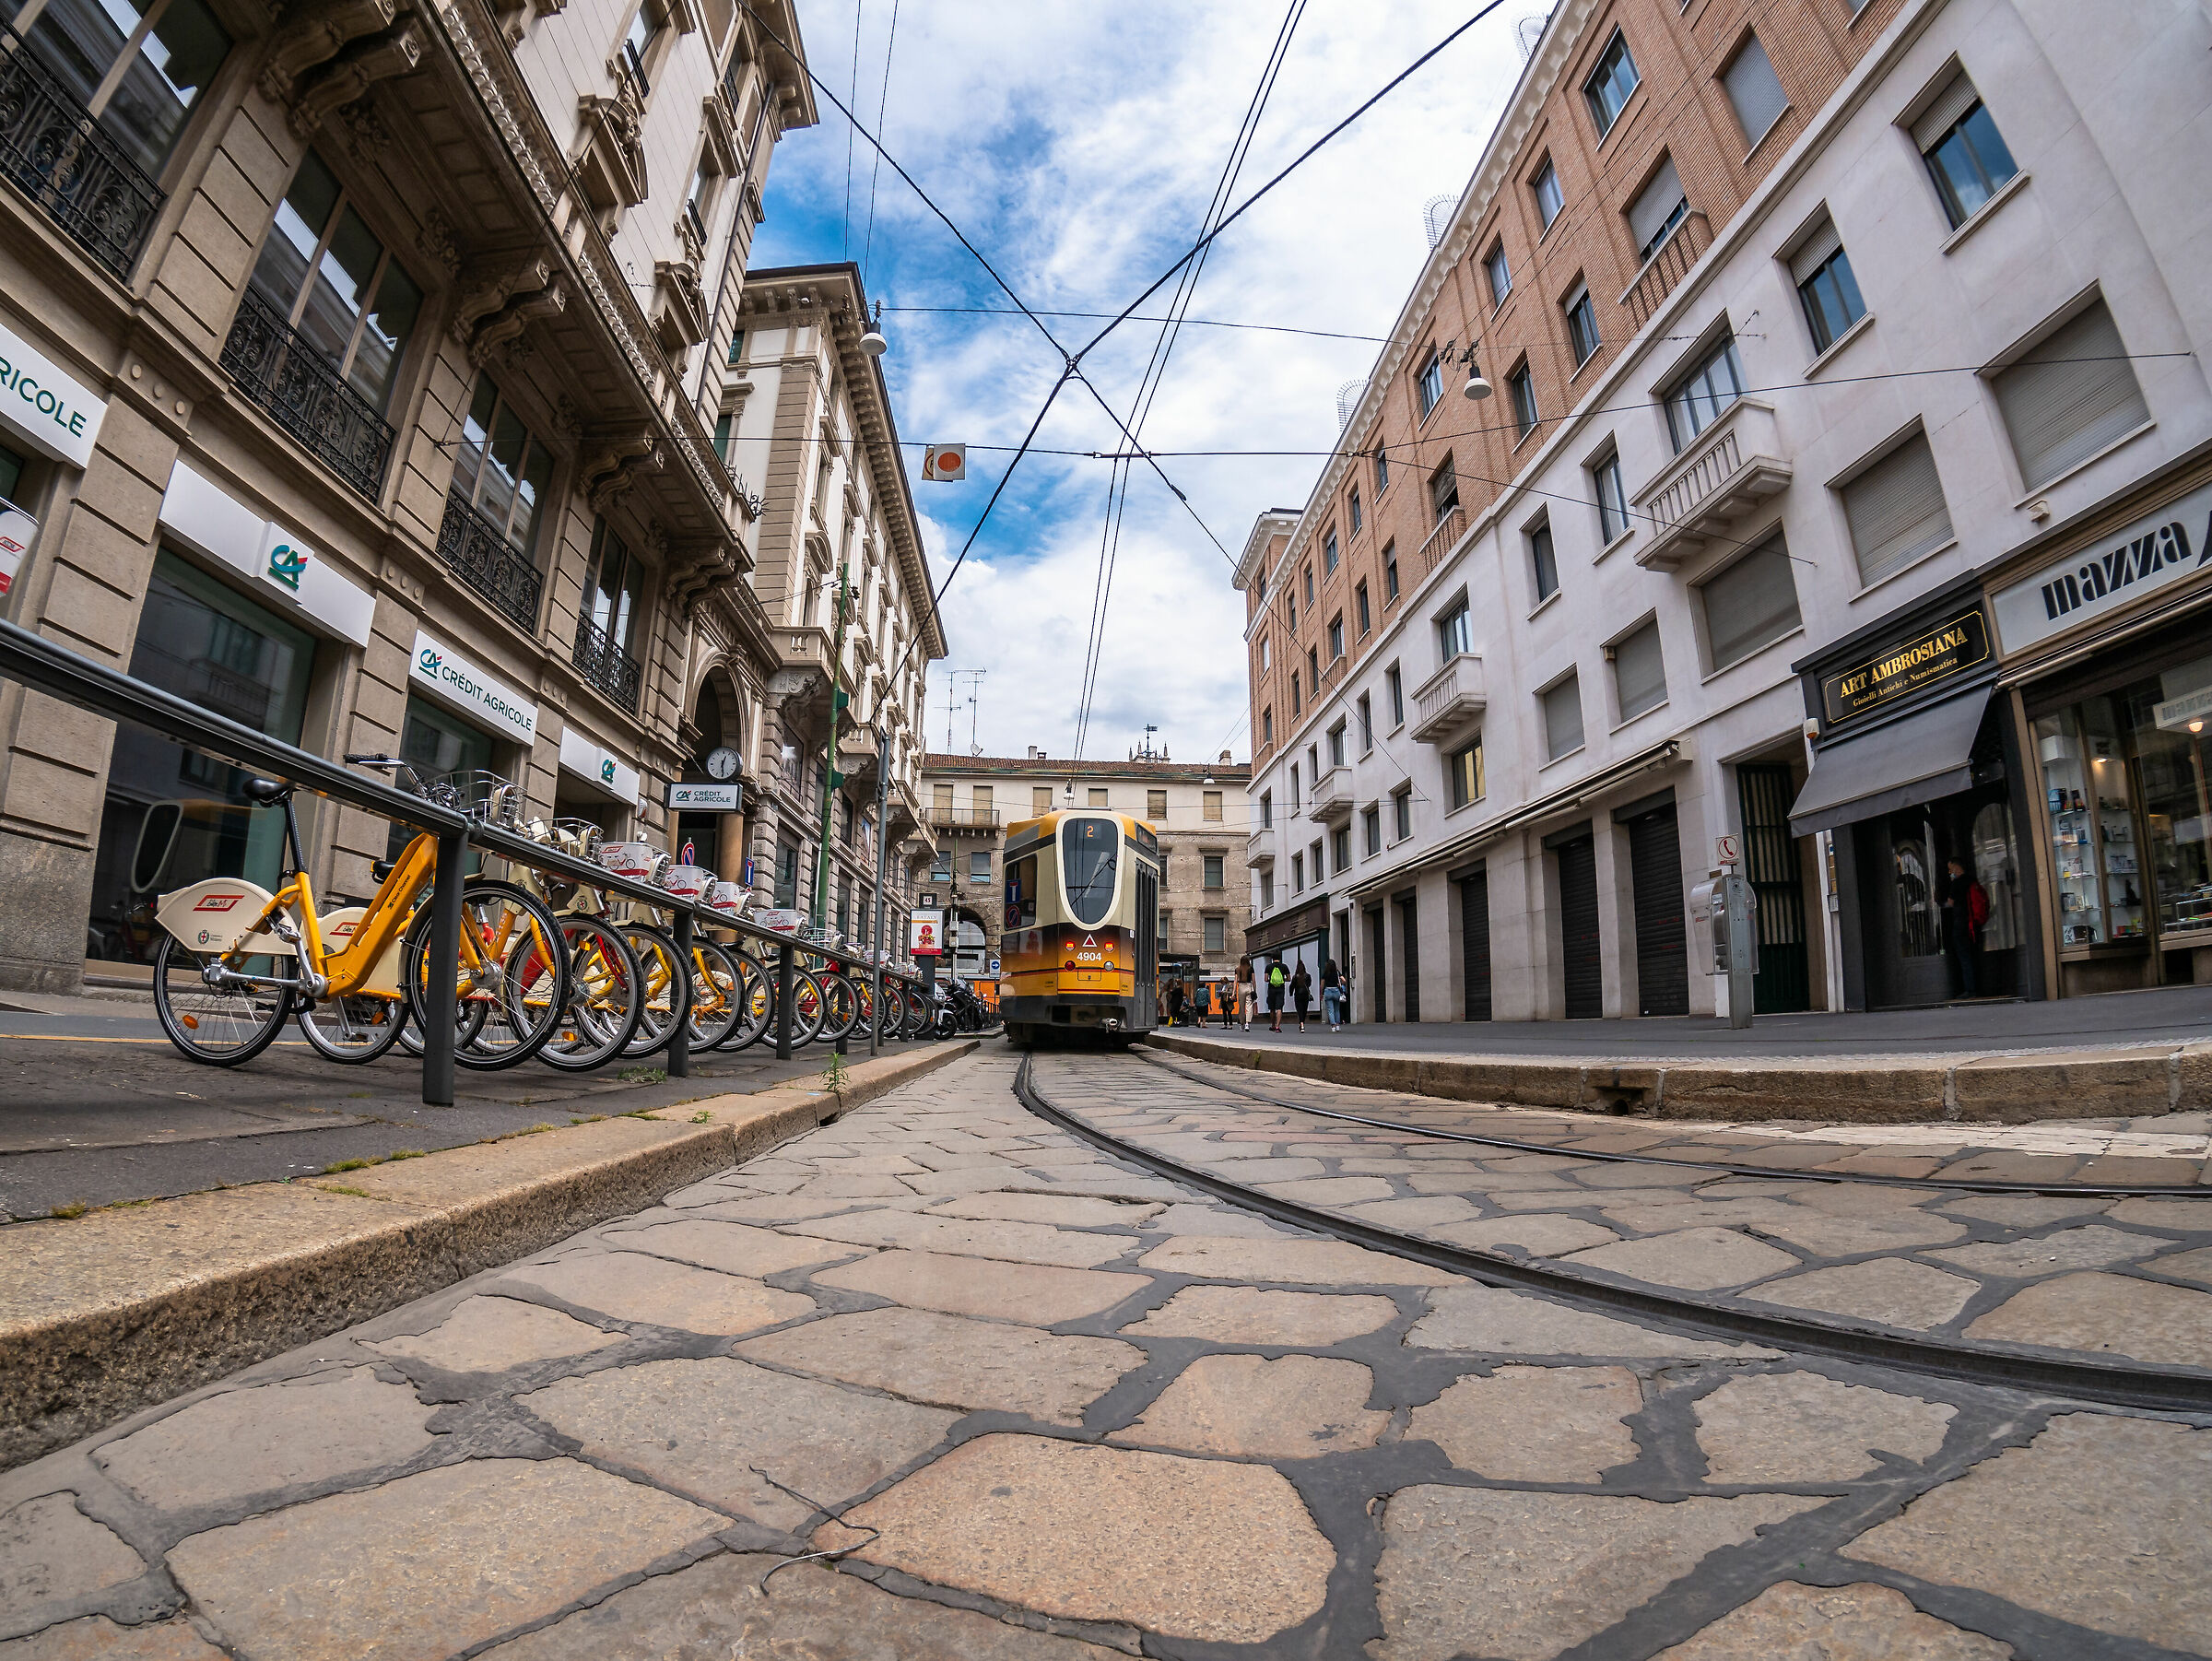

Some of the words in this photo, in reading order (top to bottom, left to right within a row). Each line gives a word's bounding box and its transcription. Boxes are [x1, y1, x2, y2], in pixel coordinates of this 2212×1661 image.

[2041, 522, 2193, 620] mazza
[1840, 672, 1867, 698] ART
[1871, 627, 1968, 684] AMBROSIANA
[1853, 693, 1877, 707] Gioielli
[1877, 679, 1903, 697] Antichi
[1910, 657, 1958, 683] Numismatica
[441, 666, 483, 700] CRÉDIT
[483, 692, 532, 731] AGRICOLE
[1087, 825, 1094, 838] 2
[1077, 952, 1102, 961] 4904
